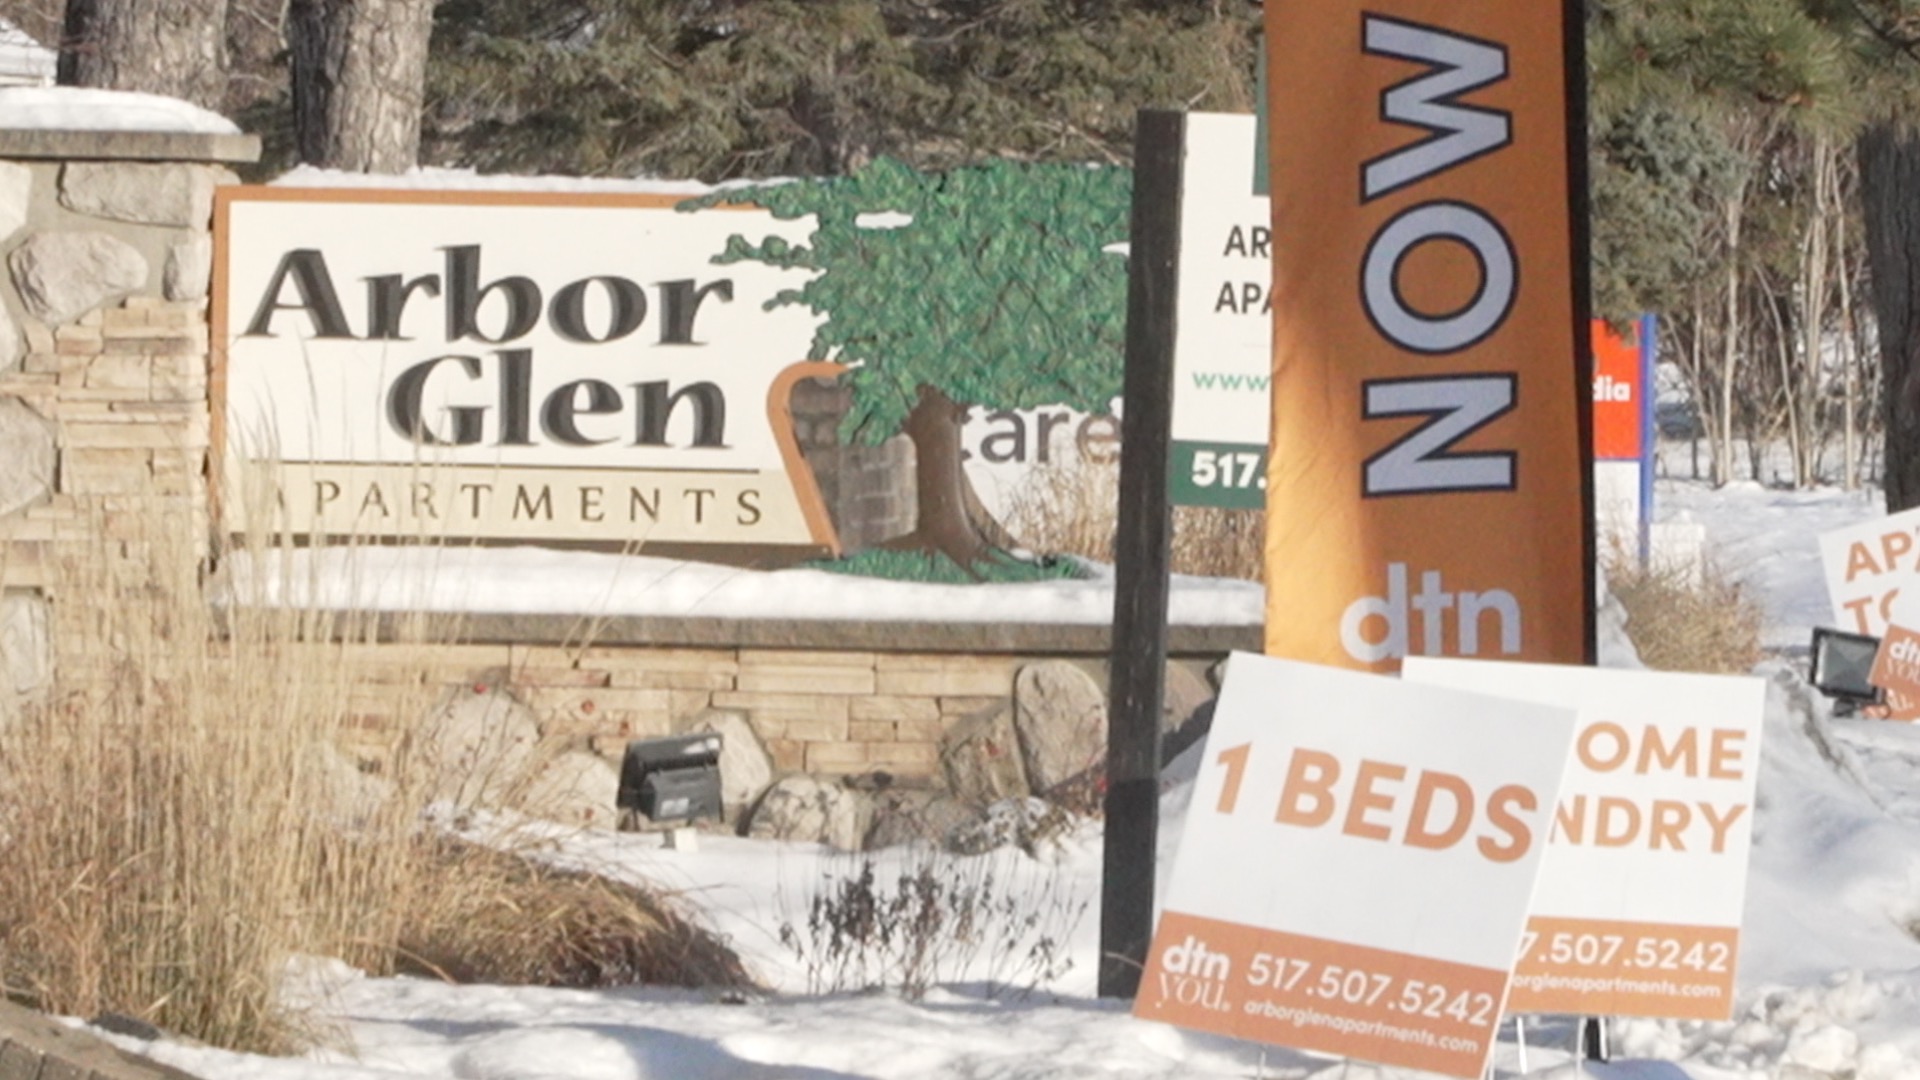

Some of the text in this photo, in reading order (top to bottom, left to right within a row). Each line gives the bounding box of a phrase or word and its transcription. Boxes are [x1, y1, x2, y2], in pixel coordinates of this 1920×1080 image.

[1360, 11, 1520, 498] NOW
[243, 244, 734, 346] Arbor
[386, 348, 732, 449] Glen
[960, 410, 1123, 464] are
[1191, 450, 1267, 490] 517.
[270, 480, 763, 526] PARTMENTS
[1845, 531, 1920, 582] AP
[1339, 562, 1522, 663] dtn
[1576, 721, 1747, 780] OME
[1216, 741, 1538, 864] 1 BEDS
[1549, 794, 1748, 854] NDRY
[1162, 935, 1230, 981] dtn
[1246, 952, 1494, 1027] 517.507.5242
